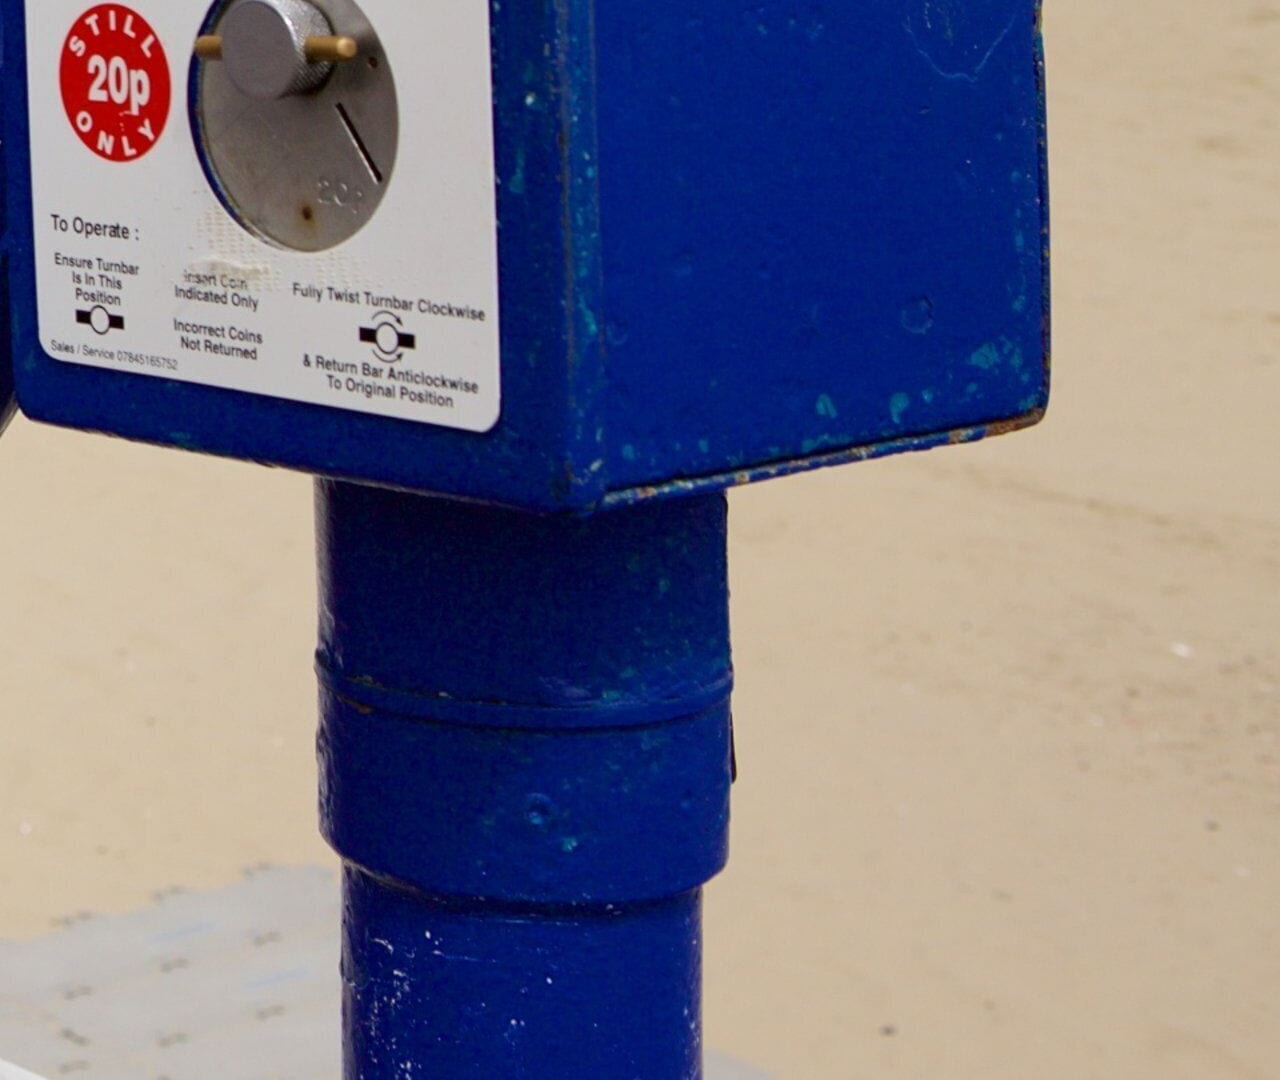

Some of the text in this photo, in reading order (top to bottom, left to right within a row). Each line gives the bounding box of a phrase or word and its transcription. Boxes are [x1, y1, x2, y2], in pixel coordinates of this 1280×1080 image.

[69, 10, 155, 58] STILL
[88, 54, 150, 115] 20p
[76, 111, 155, 156] ONLY
[51, 214, 68, 232] To
[73, 216, 129, 239] Operate
[54, 252, 139, 274] Ensure Turnbar
[72, 271, 122, 290] Is In This
[76, 287, 121, 305] Position
[175, 285, 258, 312] Indicated Only
[293, 283, 486, 321] Fully Twist Turnbar Clockwise
[174, 318, 263, 344] Incorrect Coins
[51, 340, 74, 354] Sales
[82, 344, 115, 360] Service
[181, 336, 257, 360] Not Returned
[303, 354, 479, 394] & Return Bar Anticlockwise
[327, 375, 454, 408] To Original Position
